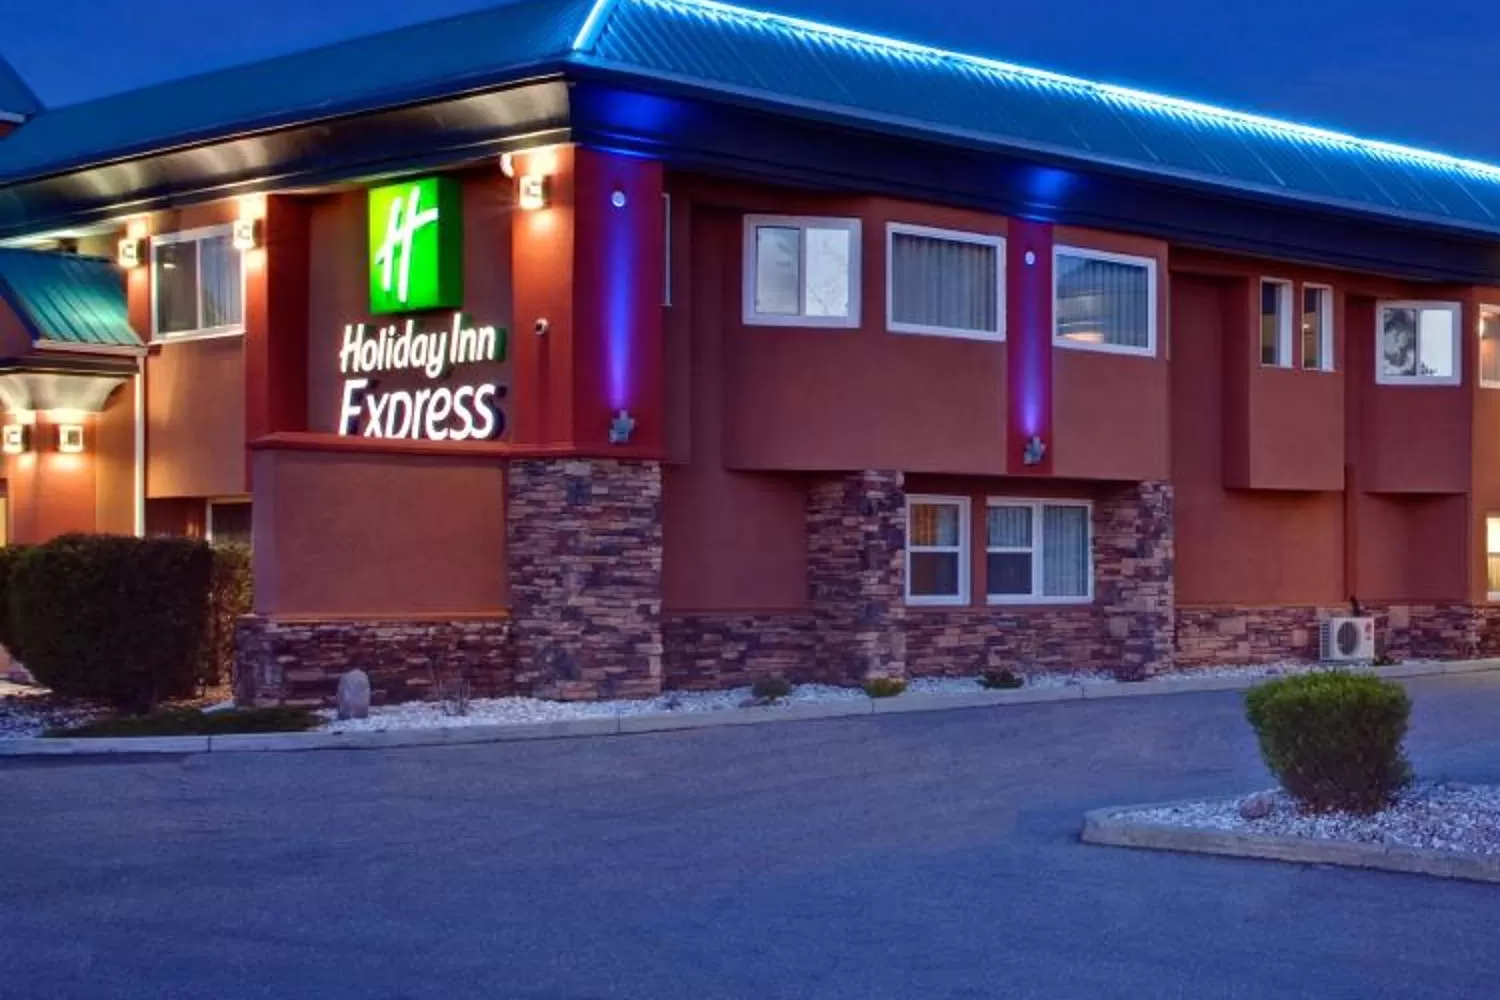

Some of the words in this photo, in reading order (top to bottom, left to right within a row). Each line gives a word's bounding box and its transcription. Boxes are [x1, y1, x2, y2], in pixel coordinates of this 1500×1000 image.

[339, 319, 447, 379] Holiday
[450, 312, 496, 365] Inn
[338, 379, 497, 441] Express
